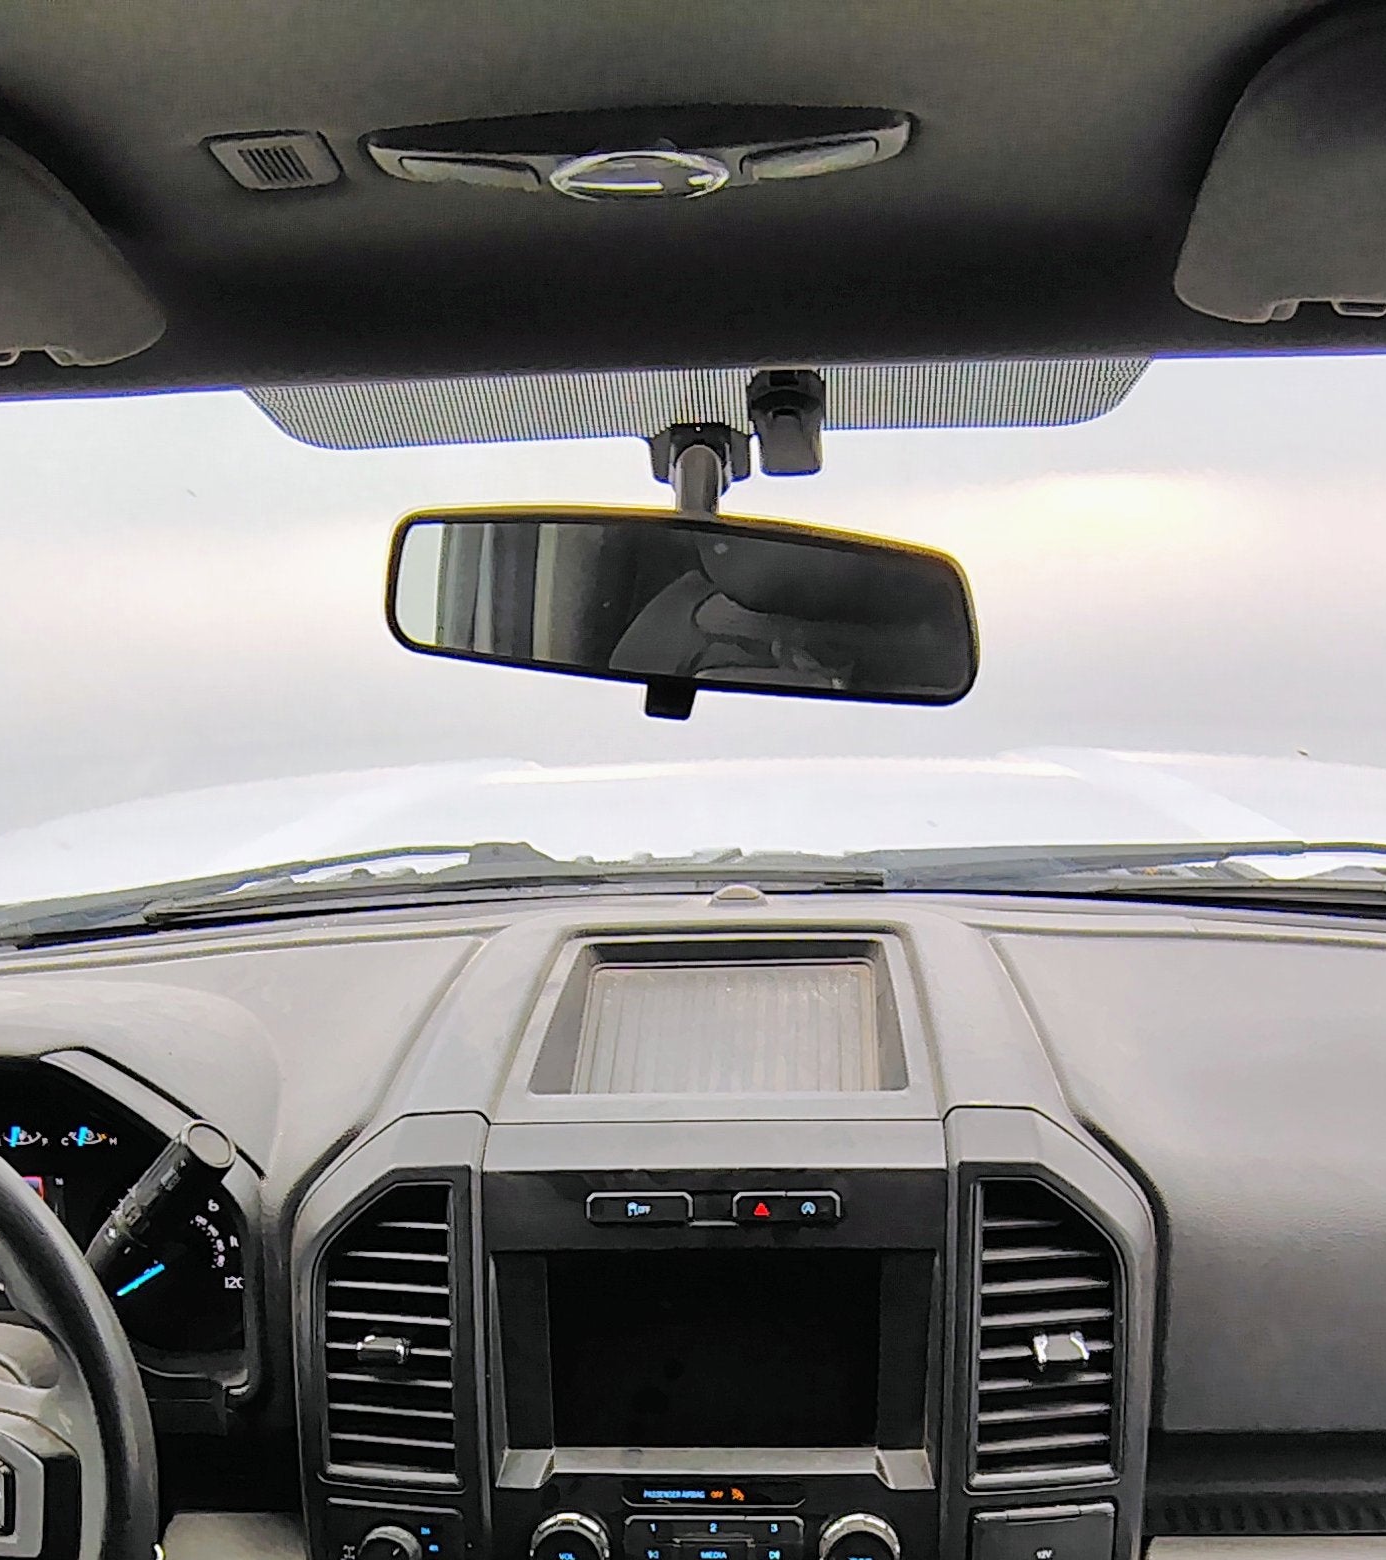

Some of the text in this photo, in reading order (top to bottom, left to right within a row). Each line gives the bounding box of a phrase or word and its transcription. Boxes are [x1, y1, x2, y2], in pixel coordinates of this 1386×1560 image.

[709, 1522, 718, 1533] 2
[770, 1523, 779, 1533] 3
[558, 1552, 576, 1560] VOL
[700, 1550, 728, 1559] MEDIA
